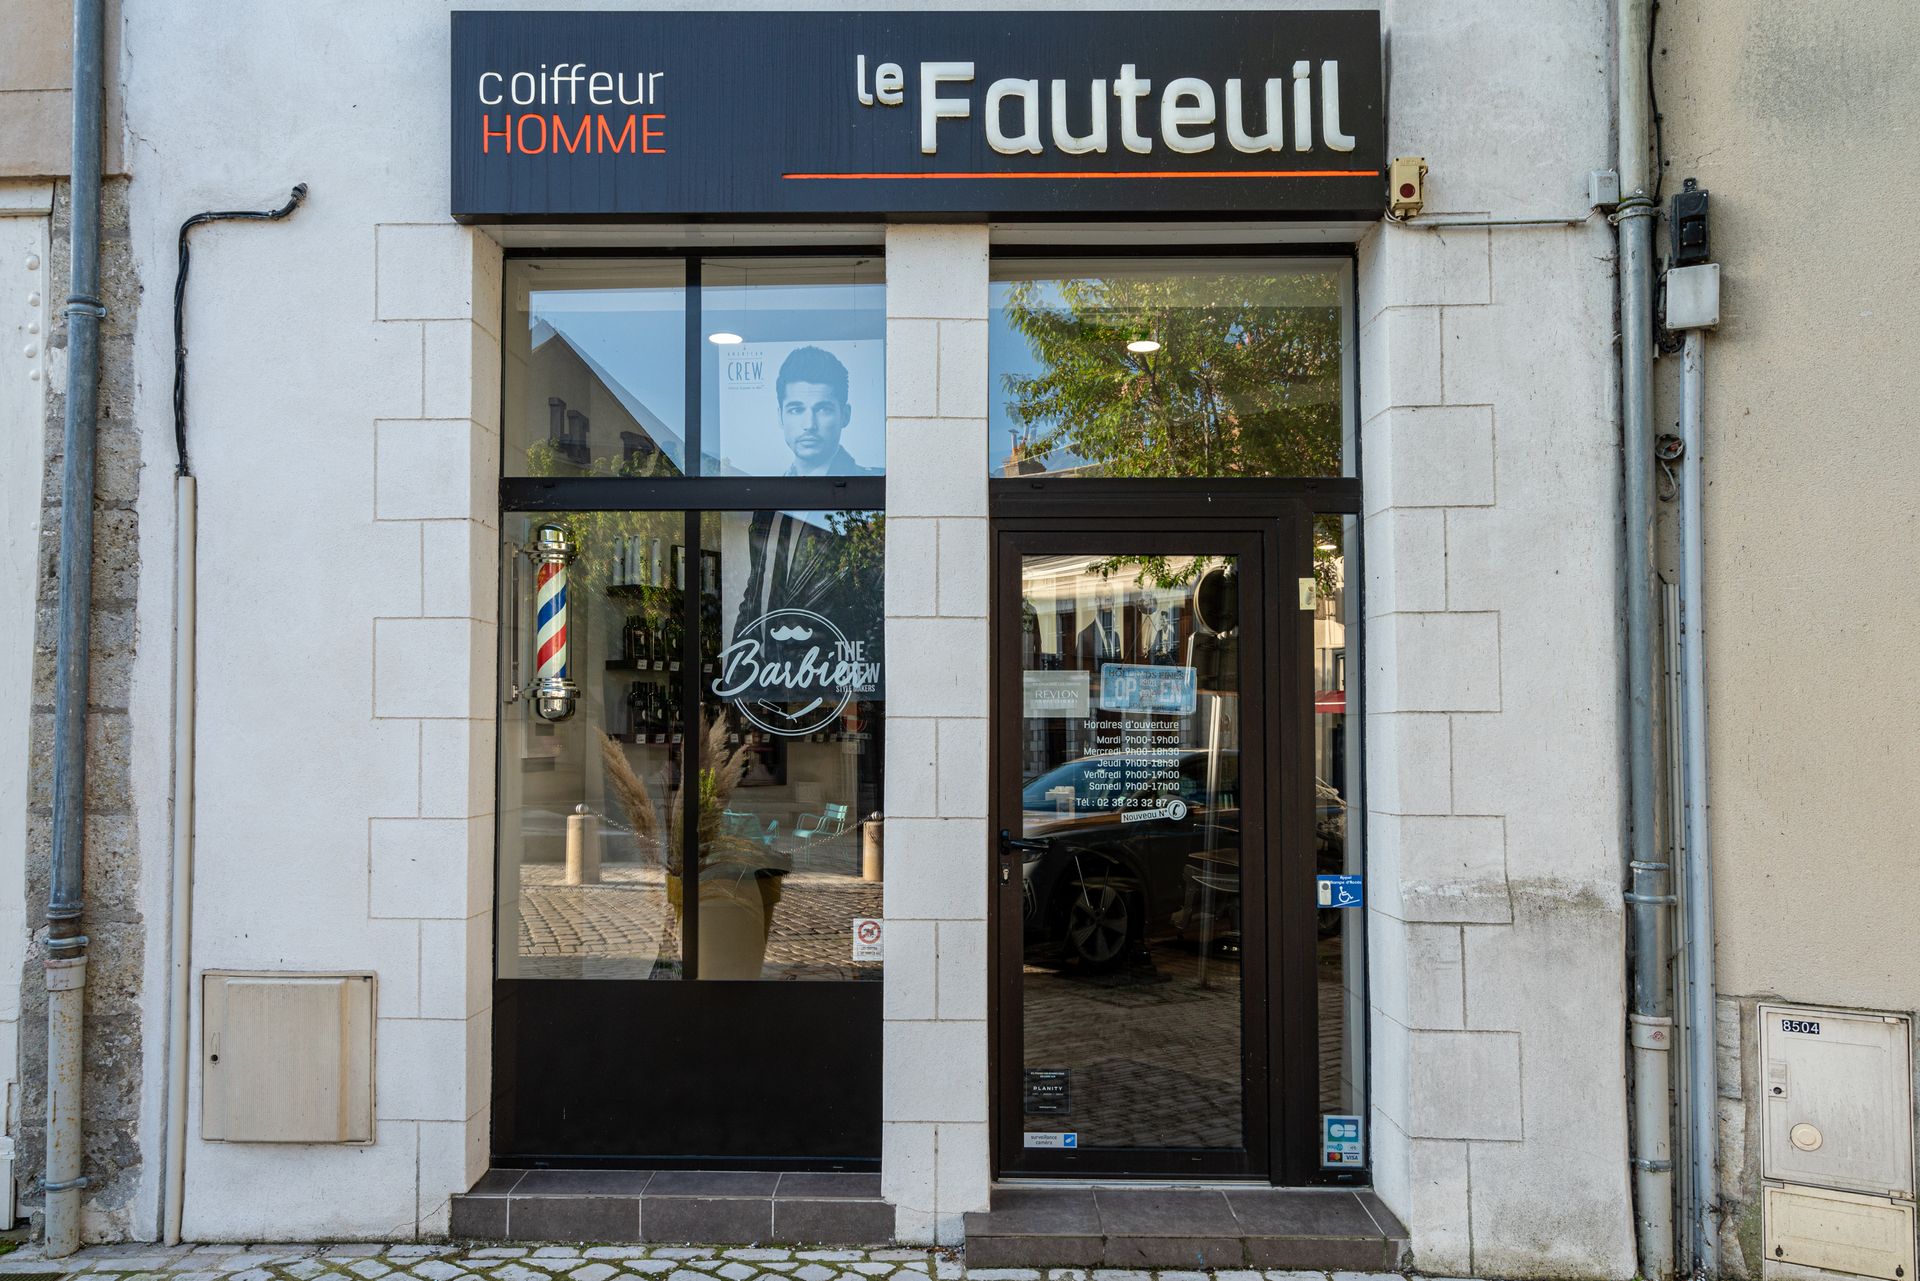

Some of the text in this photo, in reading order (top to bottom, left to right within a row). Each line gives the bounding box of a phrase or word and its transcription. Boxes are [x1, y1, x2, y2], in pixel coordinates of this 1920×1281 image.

[477, 62, 665, 106] coiffeur
[856, 53, 1356, 156] le Fauteuil
[482, 113, 667, 156] HOMME
[727, 361, 763, 382] CREW
[834, 640, 865, 662] THE
[711, 638, 870, 697] Barbier
[1035, 689, 1080, 699] REVLON
[1083, 720, 1180, 729] Horaires d'ouverture
[1096, 735, 1180, 744] Mardi 9h00-19h00
[1083, 747, 1121, 756] Mercredi
[1097, 759, 1180, 768] Jeudi 9h00-18h30
[1083, 770, 1180, 779] Vendredi 9h00-19h00
[1089, 782, 1180, 791] Samedi 9h00-17h00
[1097, 798, 1109, 807] 02
[1111, 798, 1124, 807] 38
[1126, 798, 1139, 807] 23
[1140, 798, 1153, 807] 32
[1123, 812, 1157, 822] Nouveau
[1783, 1020, 1819, 1034] 8504
[1330, 1124, 1357, 1137] CB
